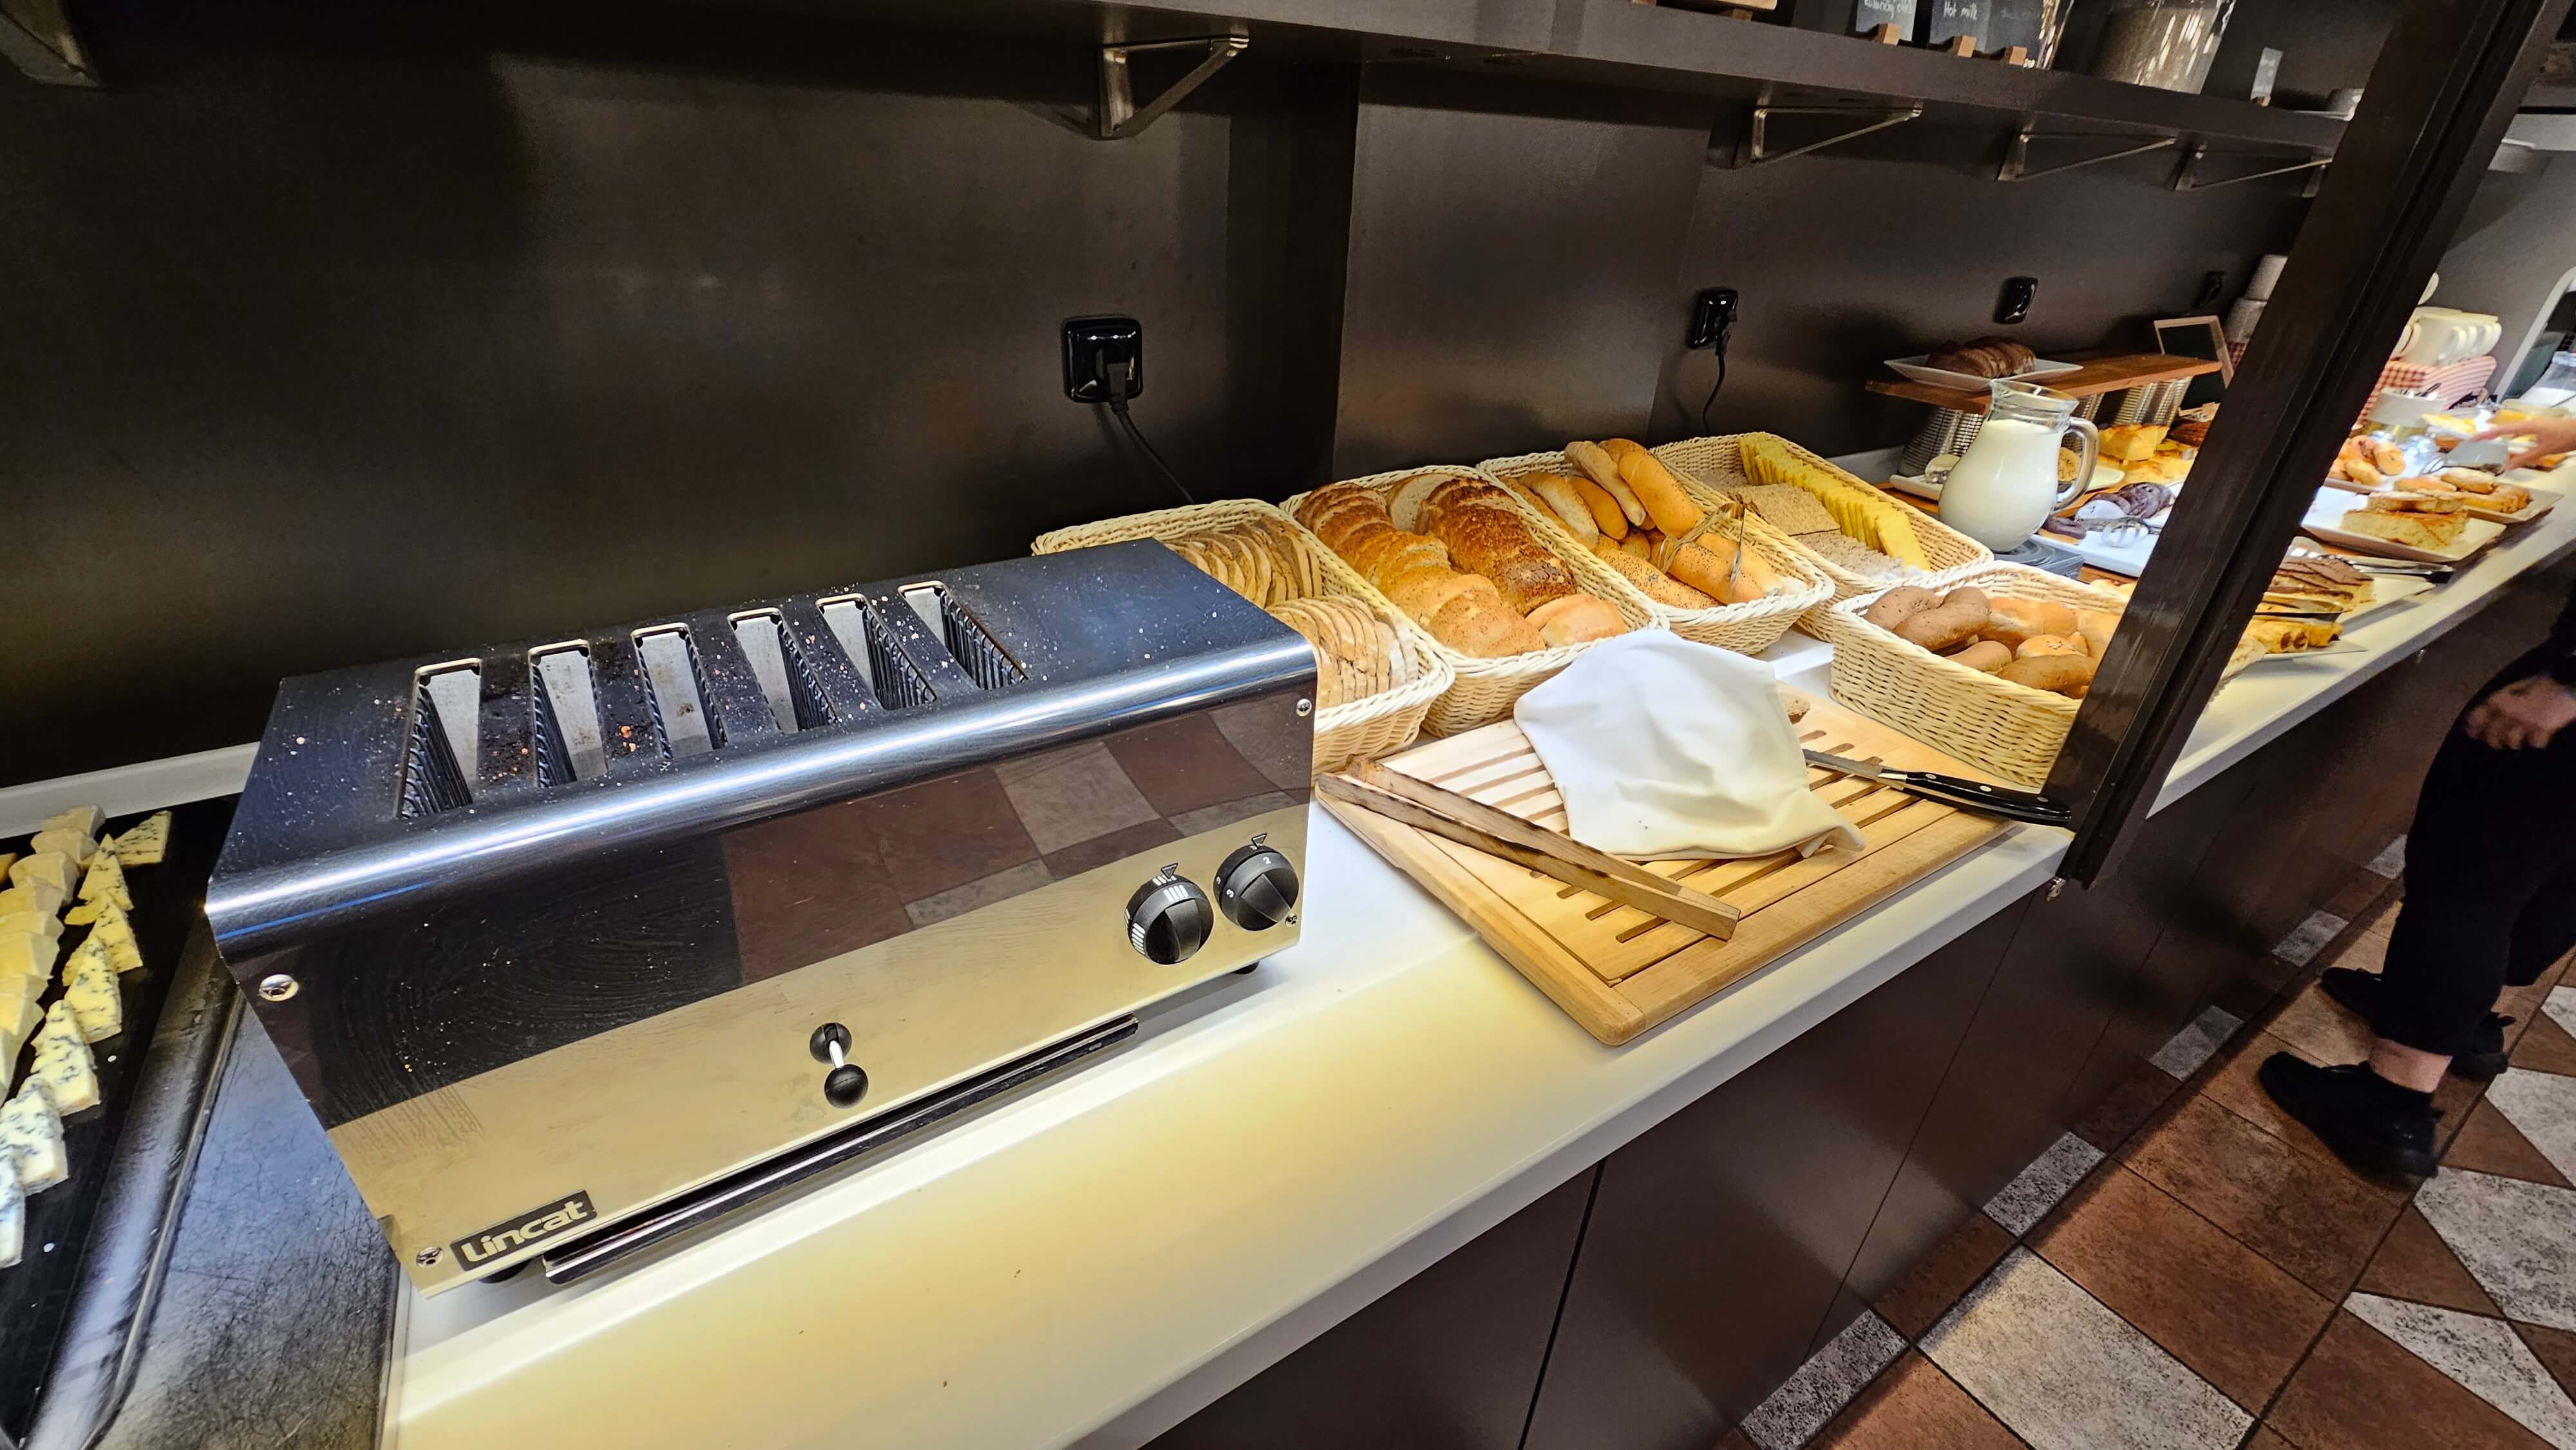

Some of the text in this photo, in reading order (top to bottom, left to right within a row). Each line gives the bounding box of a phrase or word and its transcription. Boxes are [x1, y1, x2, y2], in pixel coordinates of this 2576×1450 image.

[1943, 0, 1978, 21] Hot milk
[1263, 856, 1271, 865] 2
[1226, 889, 1235, 898] 3
[461, 1200, 588, 1263] Lincat
